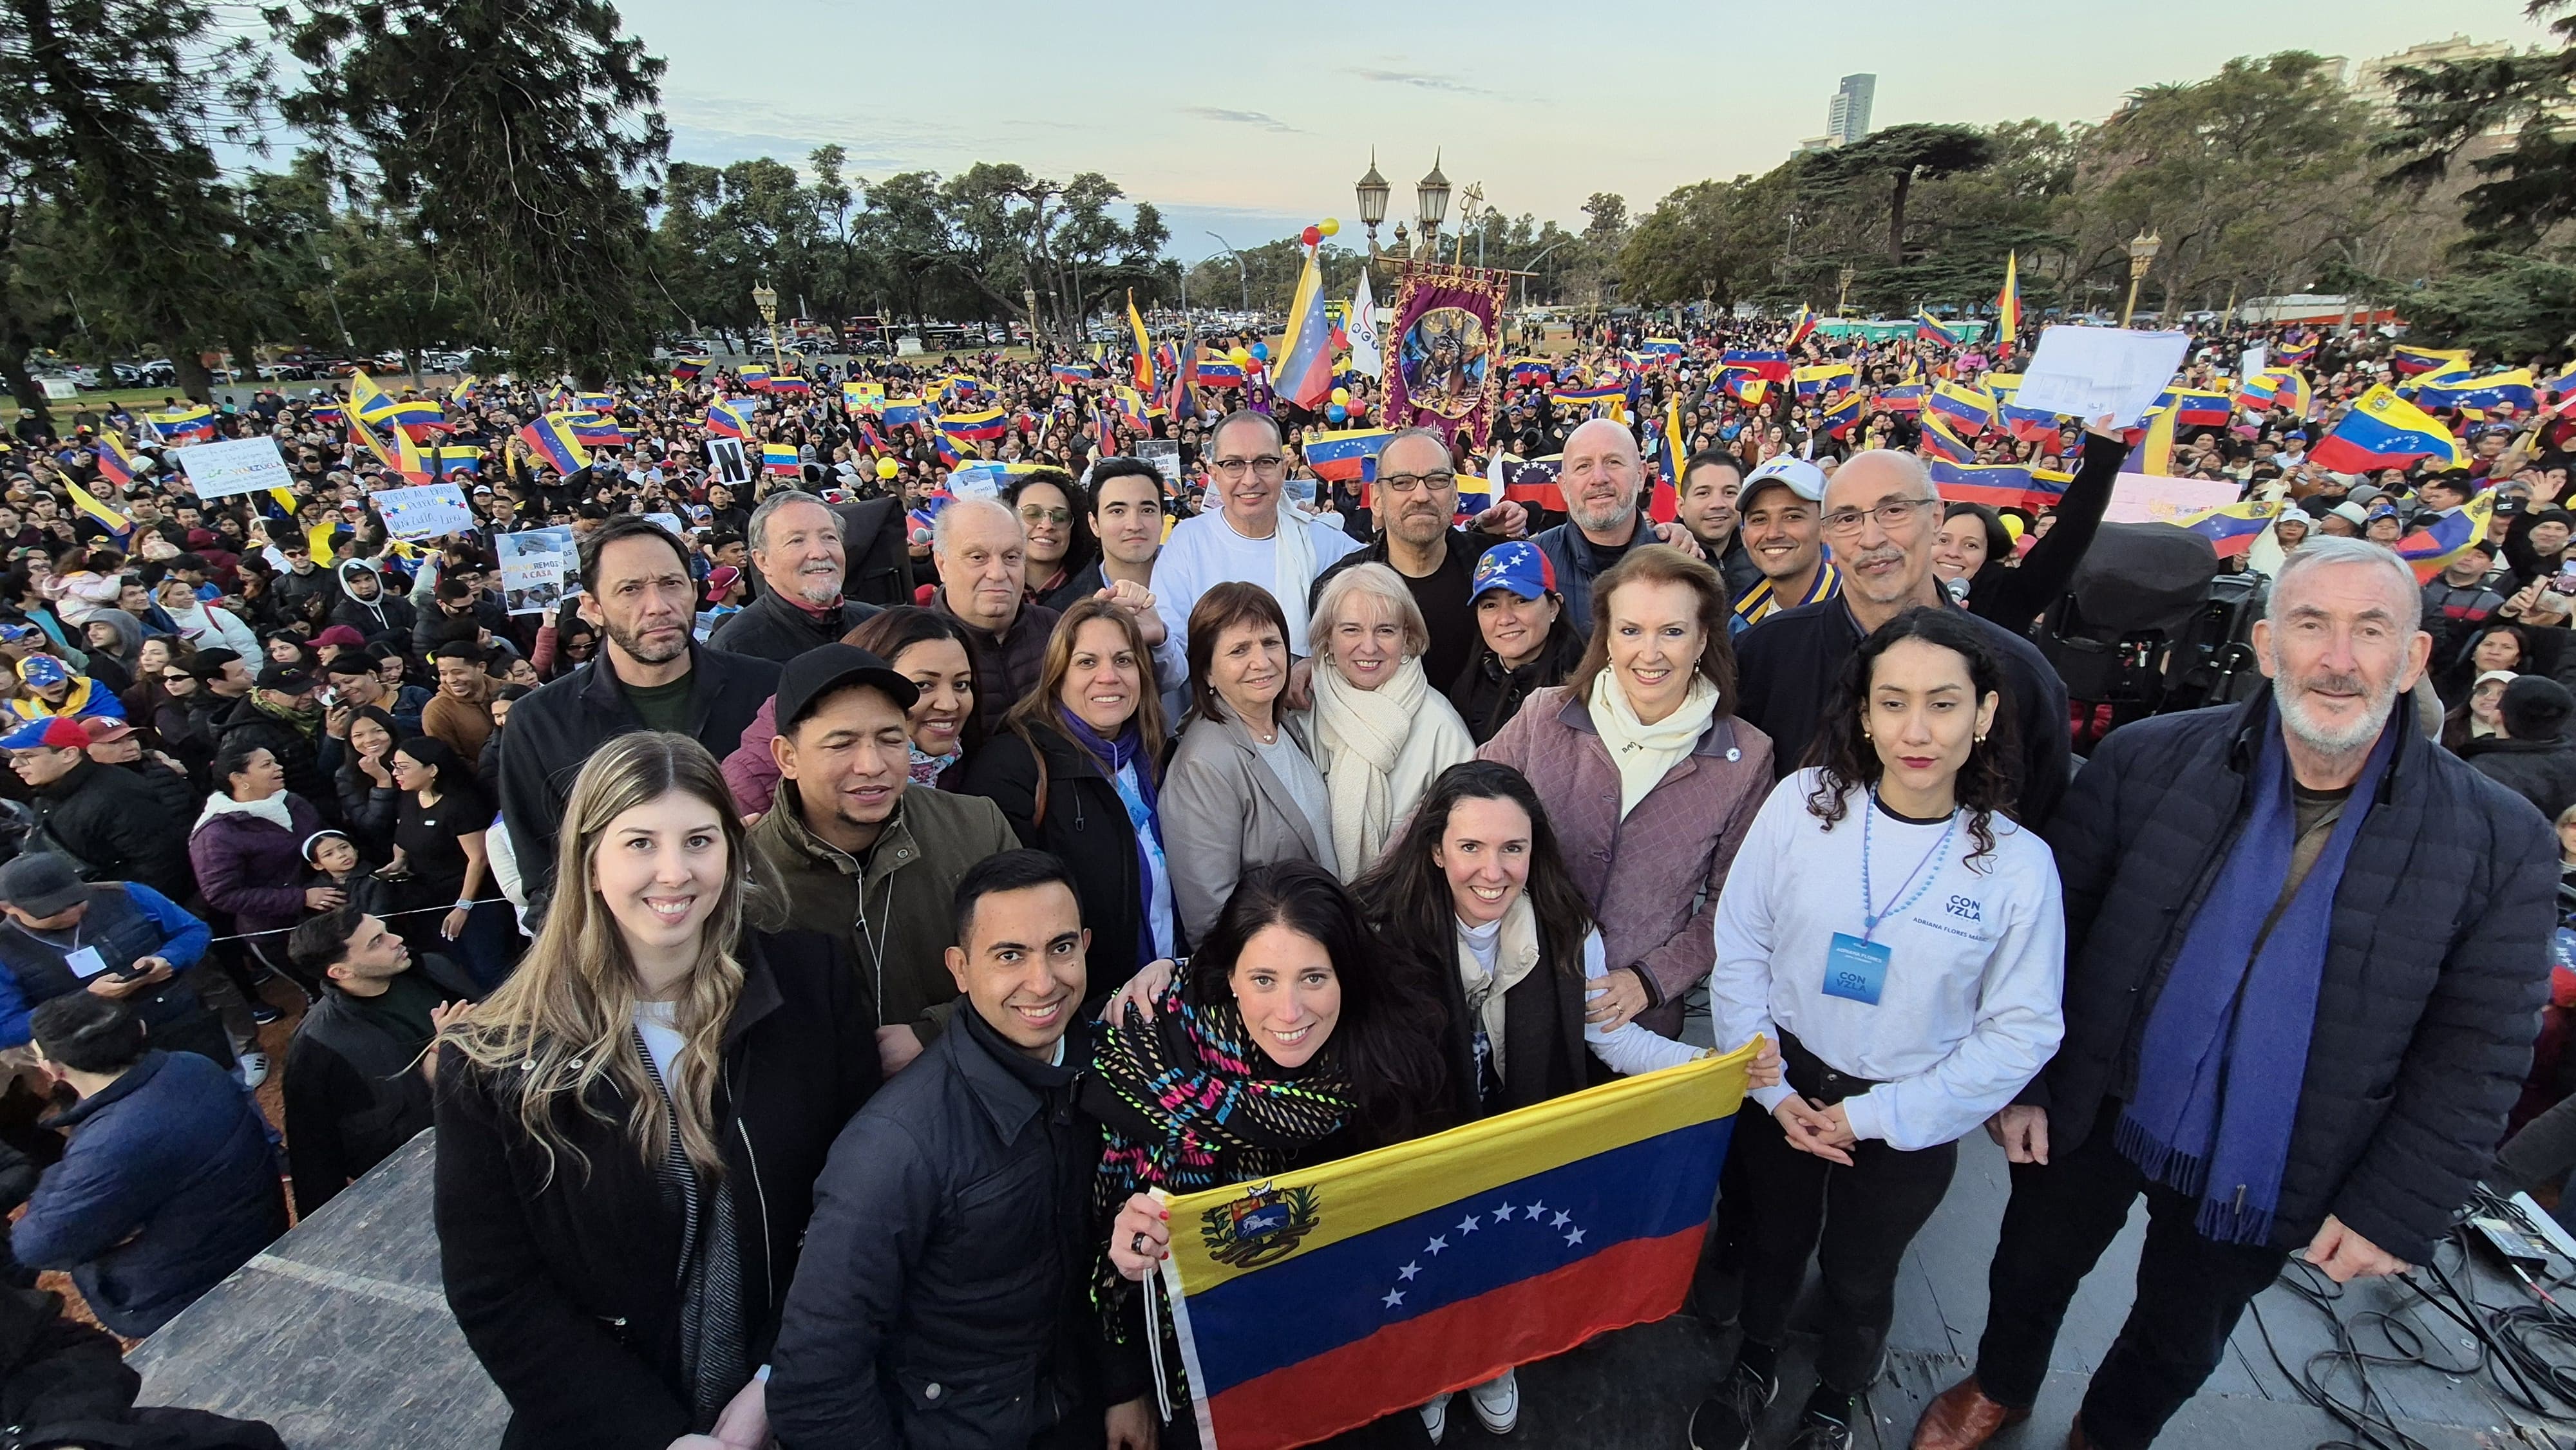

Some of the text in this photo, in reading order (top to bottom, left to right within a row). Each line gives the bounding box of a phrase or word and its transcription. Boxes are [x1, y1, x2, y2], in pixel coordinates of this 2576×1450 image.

[714, 442, 745, 482] N
[378, 492, 409, 504] GLORIA
[406, 498, 438, 511] PUEBLO
[530, 570, 553, 578] CASA
[1951, 895, 1980, 911] CON
[1946, 903, 1981, 922] VZLA
[1913, 917, 1942, 930] ADRIANA
[1944, 927, 1968, 937] FLORES
[1839, 971, 1866, 984] CON
[1836, 978, 1866, 993] VZLA
